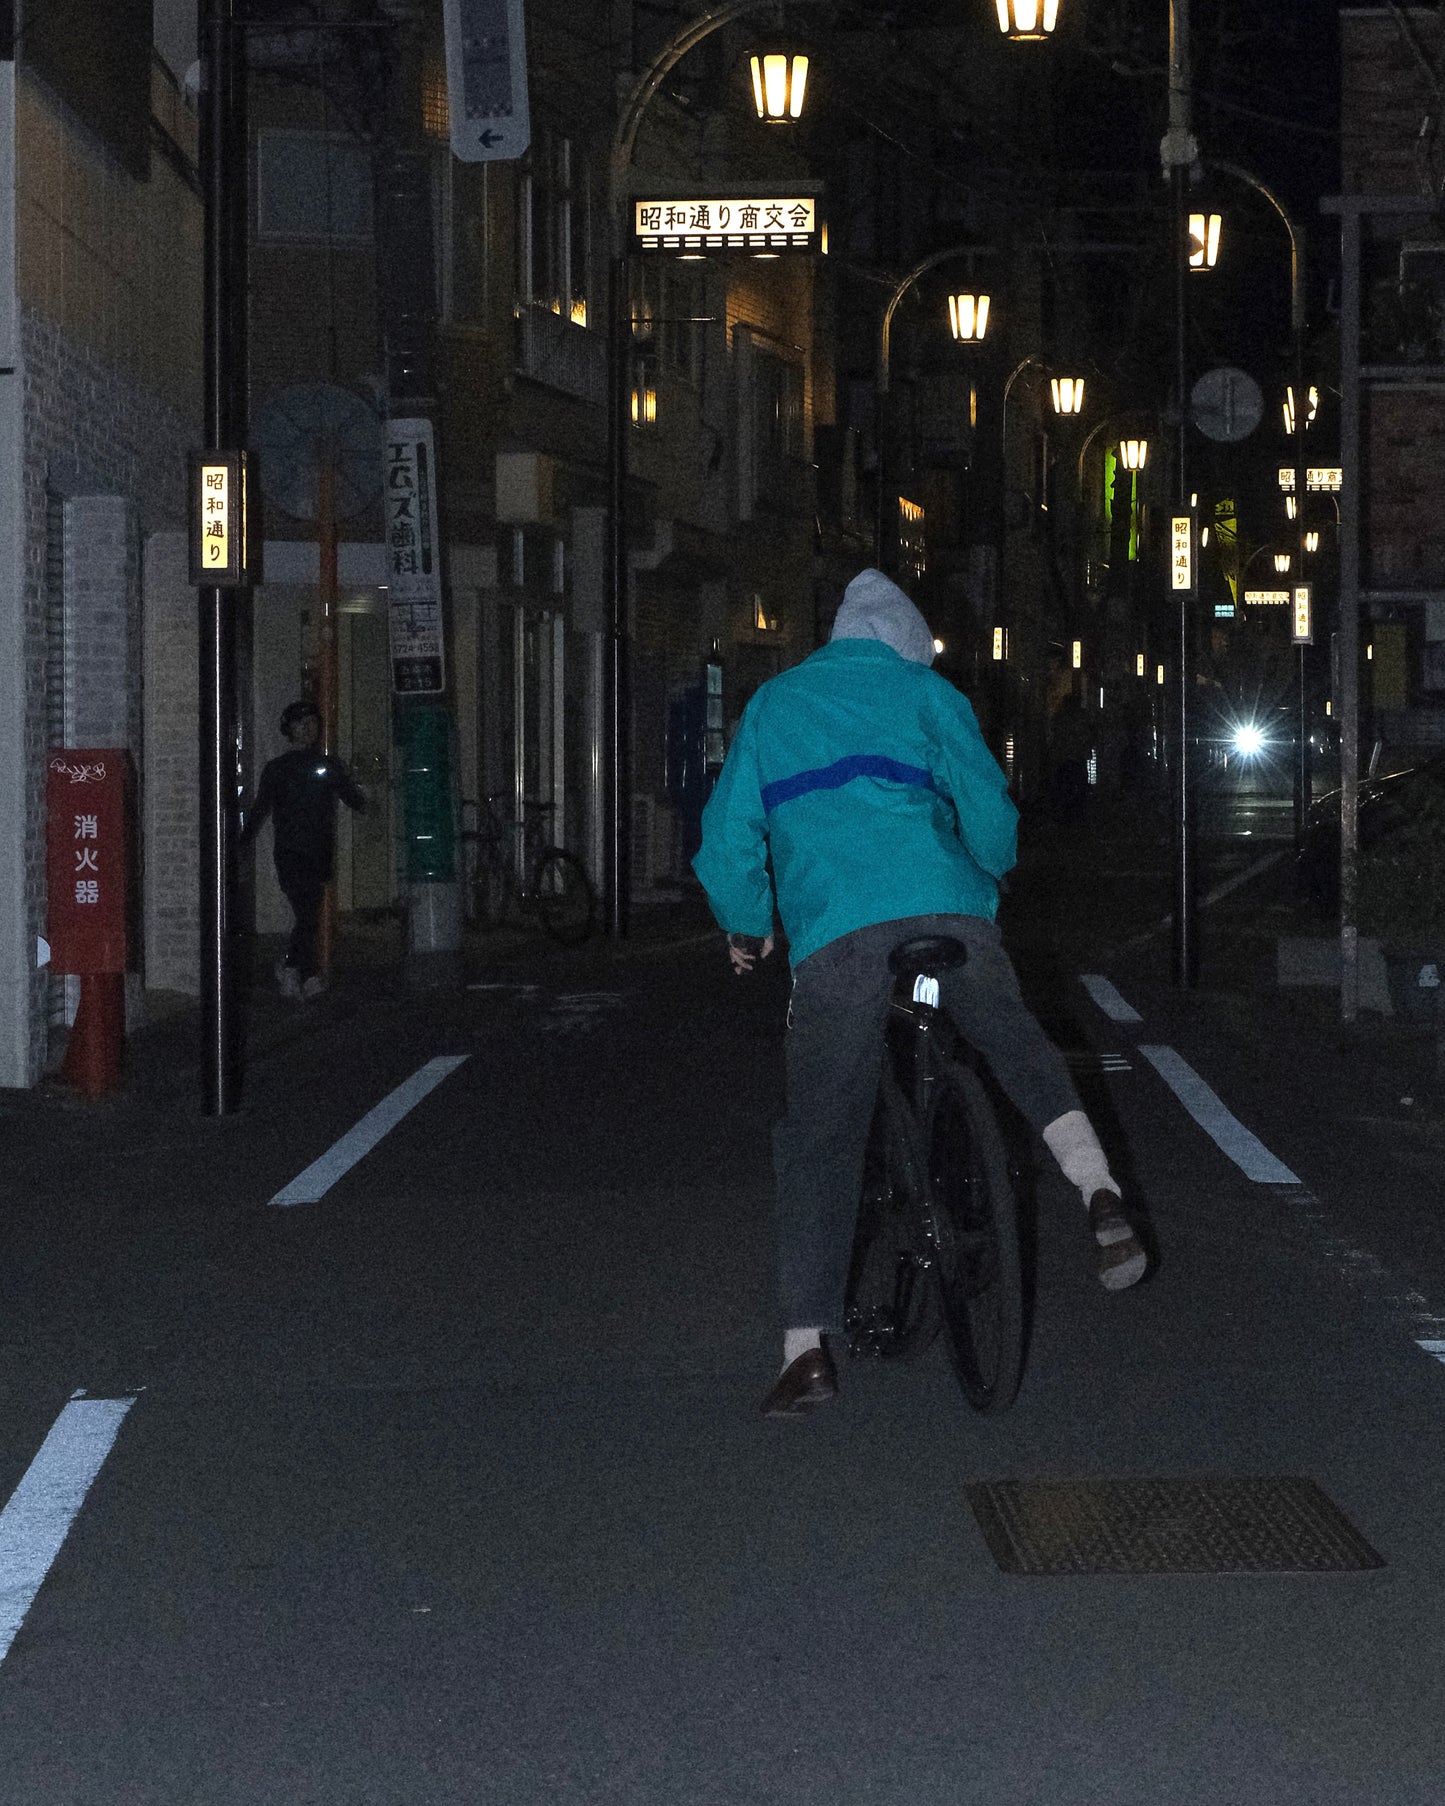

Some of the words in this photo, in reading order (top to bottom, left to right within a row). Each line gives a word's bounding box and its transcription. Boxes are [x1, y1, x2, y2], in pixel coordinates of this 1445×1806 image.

[640, 203, 811, 231] 昭和通り商交会
[206, 473, 225, 562] 昭和通り
[1175, 522, 1188, 584] 昭和通り
[74, 814, 99, 904] 消火器
